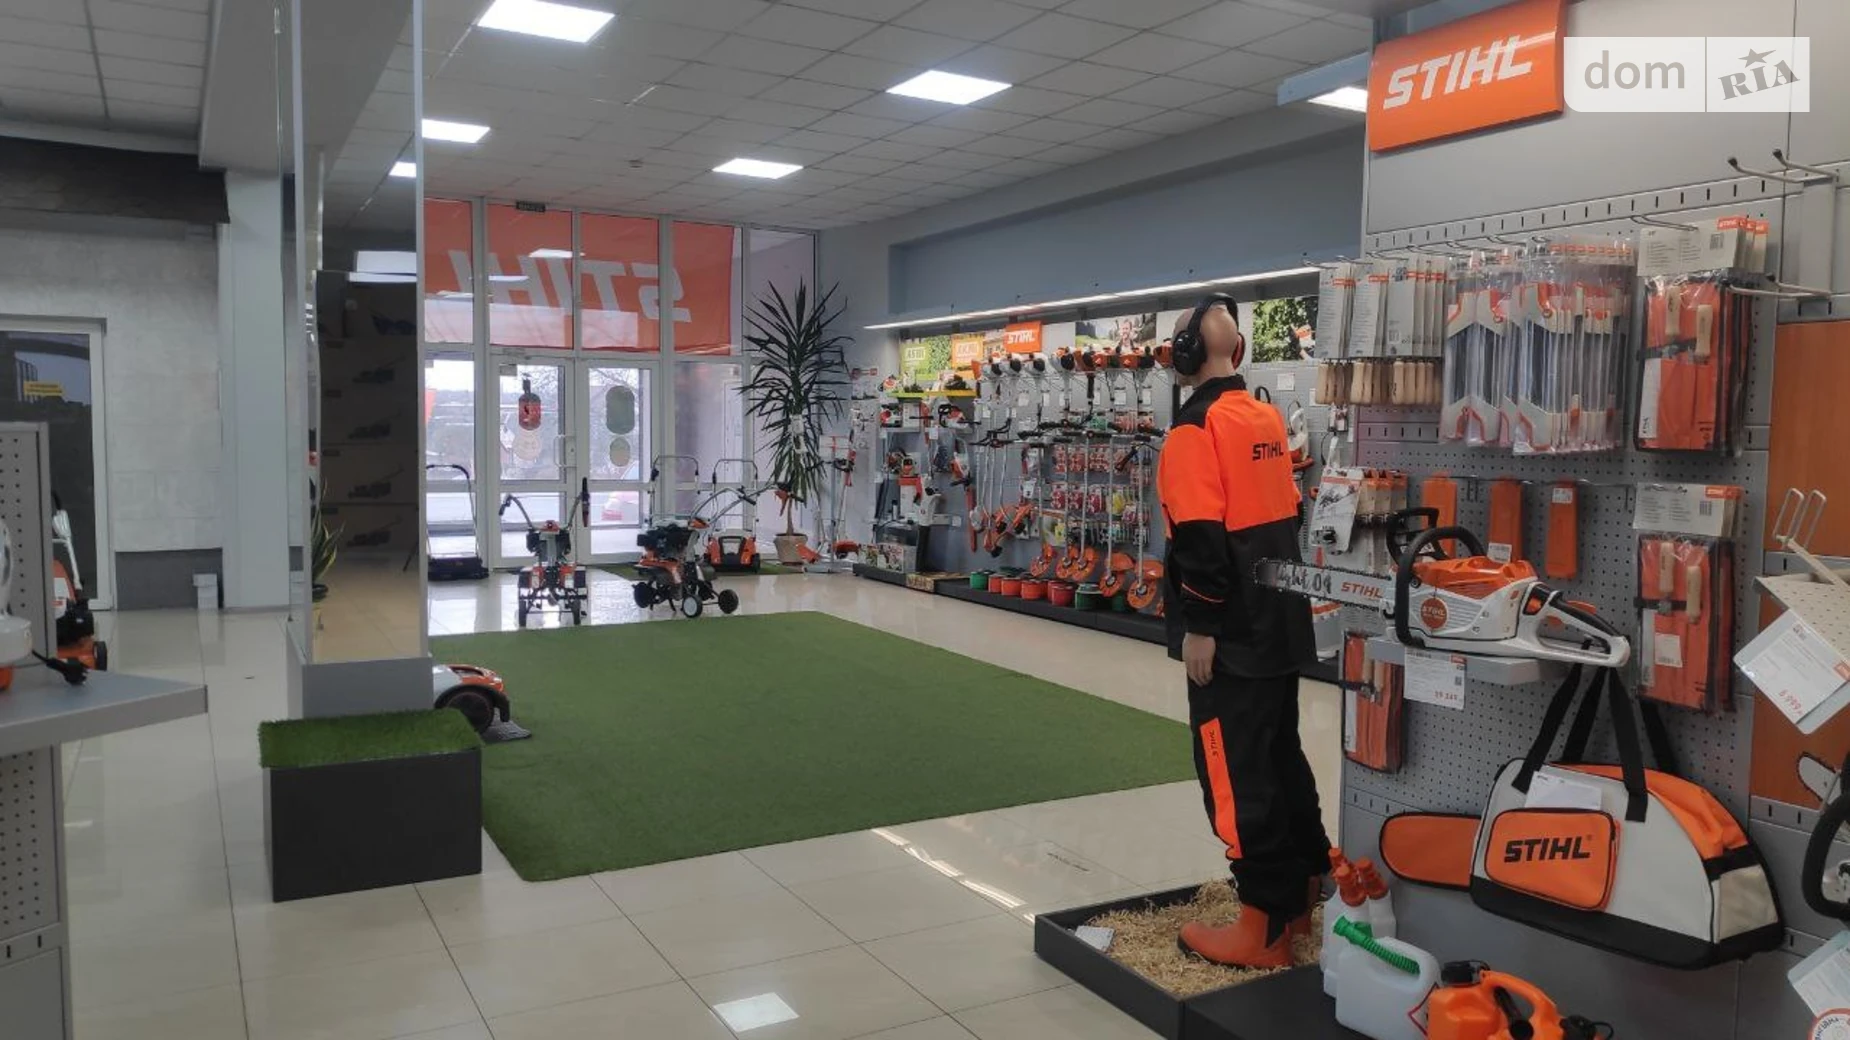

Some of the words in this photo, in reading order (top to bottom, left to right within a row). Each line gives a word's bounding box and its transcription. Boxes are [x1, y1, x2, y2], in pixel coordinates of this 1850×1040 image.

[1383, 35, 1533, 110] STIHL
[1006, 330, 1036, 344] STIHL
[1252, 441, 1284, 461] STIHL
[1341, 581, 1384, 599] STIHL
[1209, 729, 1219, 756] STIHL
[1504, 836, 1590, 863] STIHL
